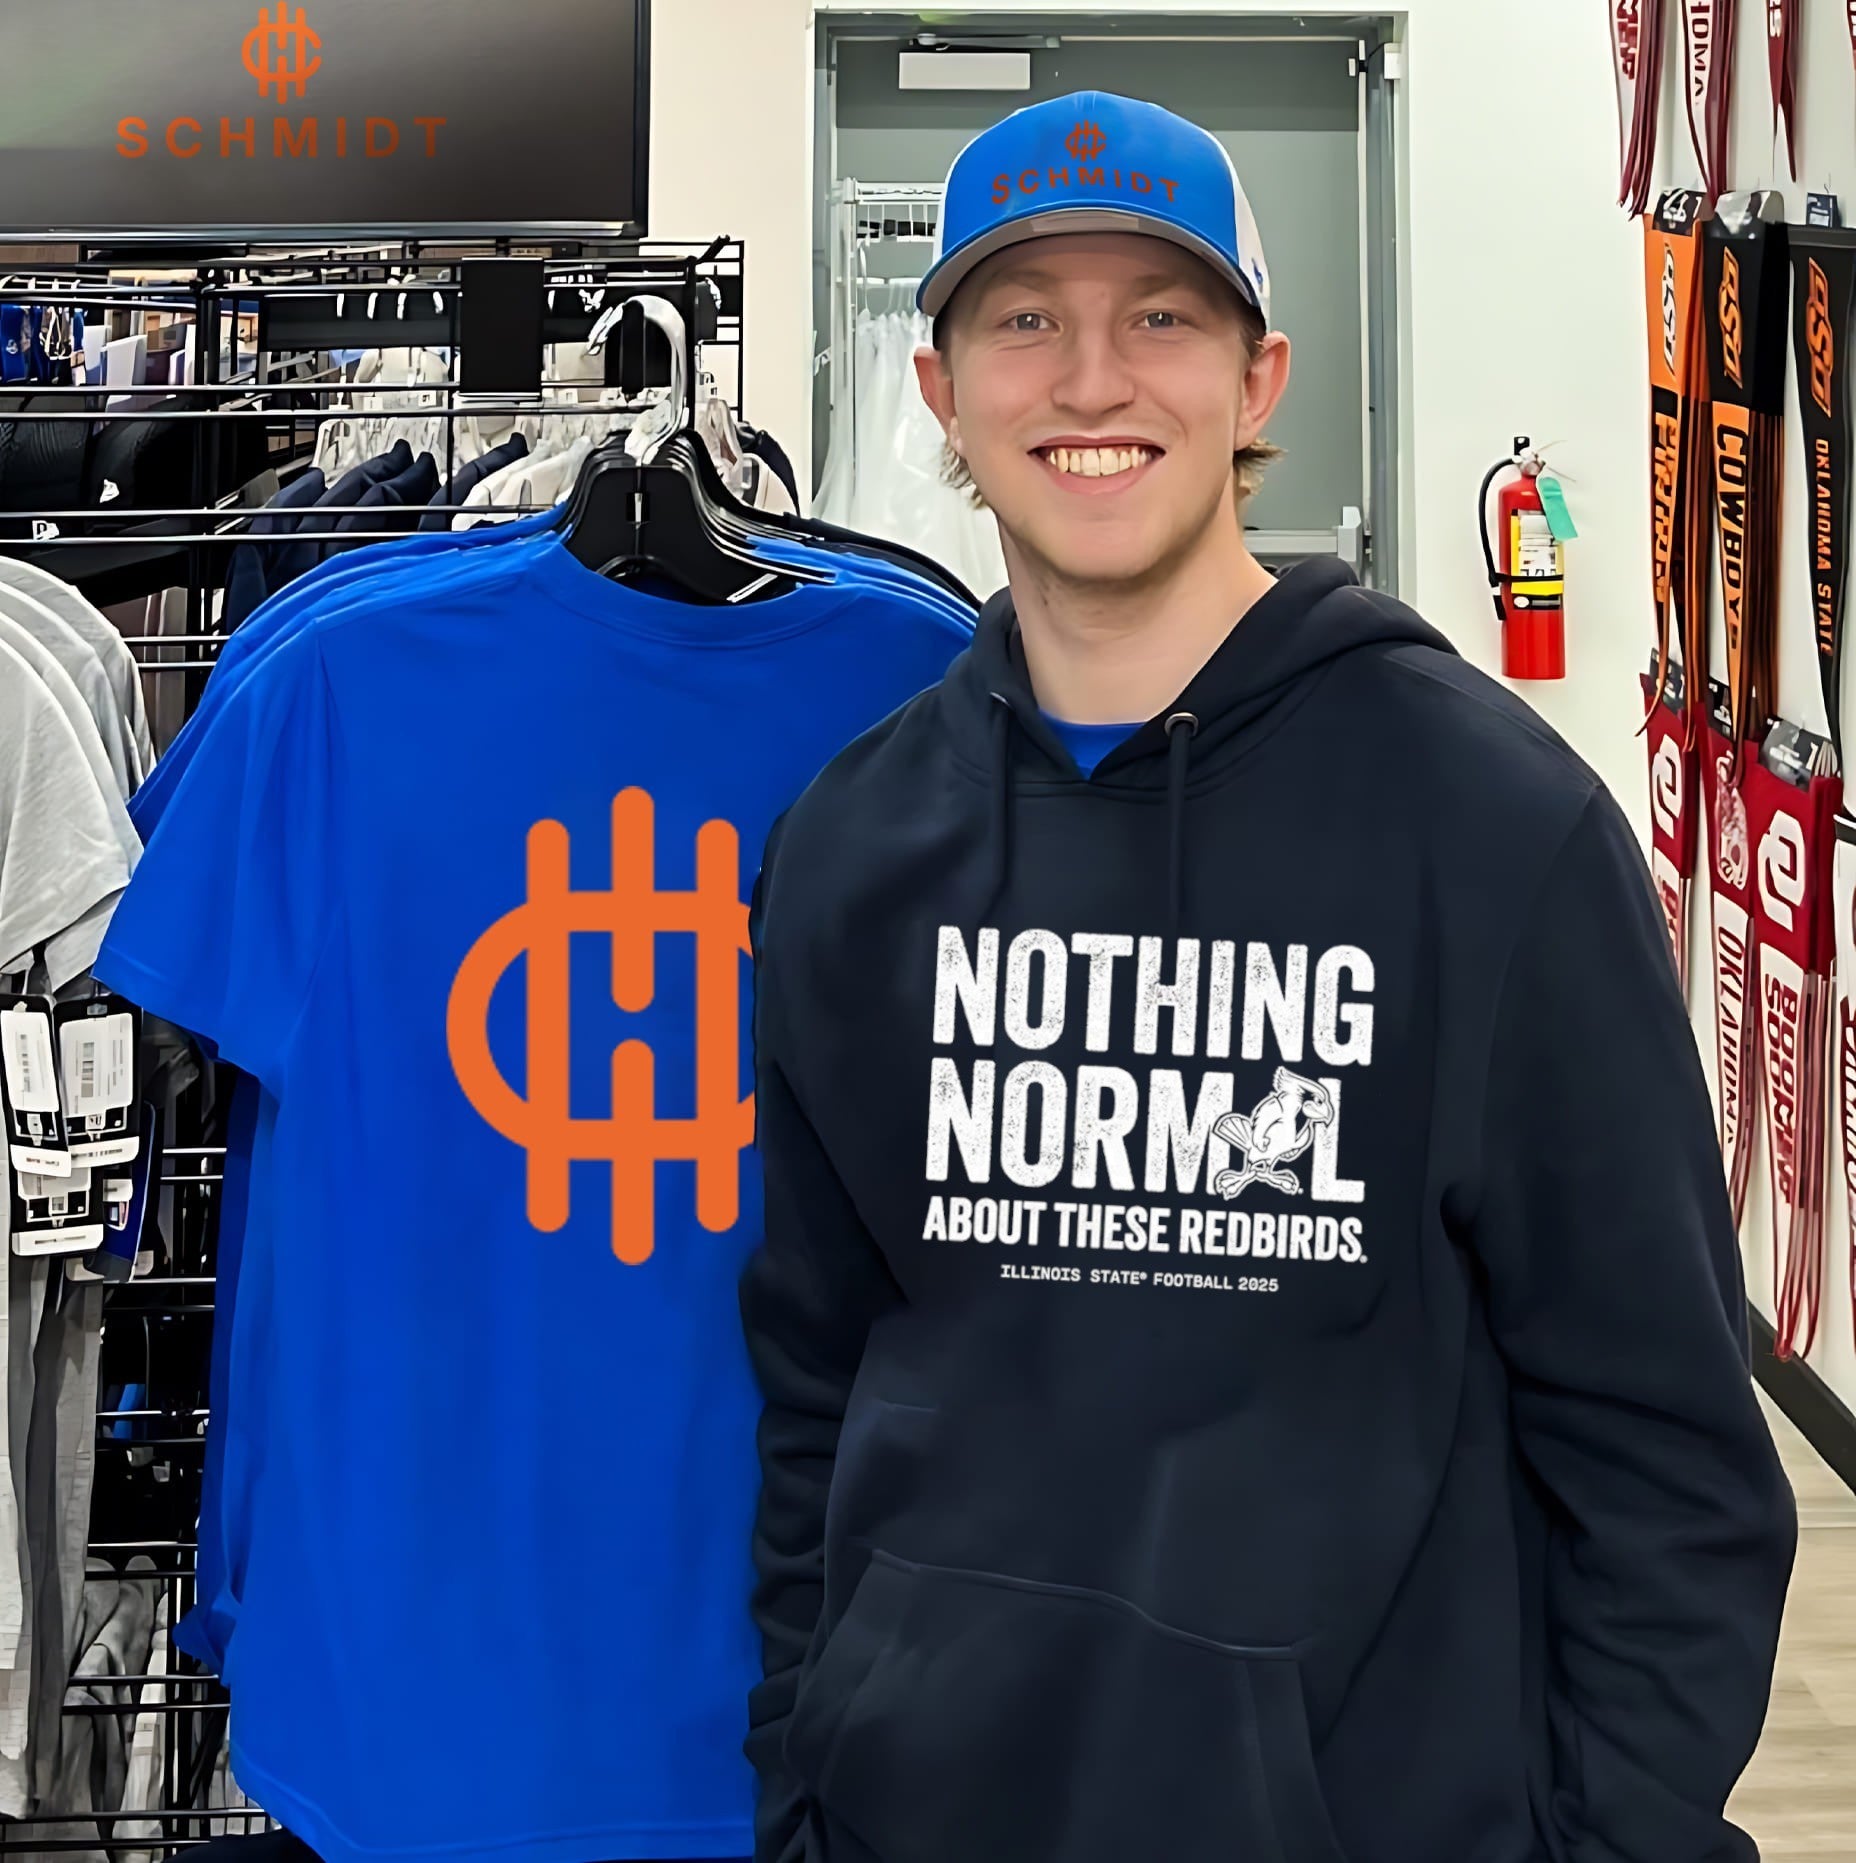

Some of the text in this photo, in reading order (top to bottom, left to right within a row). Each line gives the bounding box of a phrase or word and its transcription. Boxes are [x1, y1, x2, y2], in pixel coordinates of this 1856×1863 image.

[116, 116, 448, 159] SCHMIDT
[991, 167, 1179, 204] SCHMIDT
[1758, 809, 1806, 933] OU
[932, 925, 1376, 1067] NOTHING
[1718, 926, 1744, 1144] OKLAHOMA
[925, 1057, 1366, 1203] NORML
[922, 1196, 1047, 1247] ABOUT
[1054, 1202, 1171, 1252] THESE
[1000, 1264, 1081, 1282] ILLINOIS
[1153, 1272, 1234, 1291] FOOTBALL
[1238, 1277, 1280, 1292] 2025
